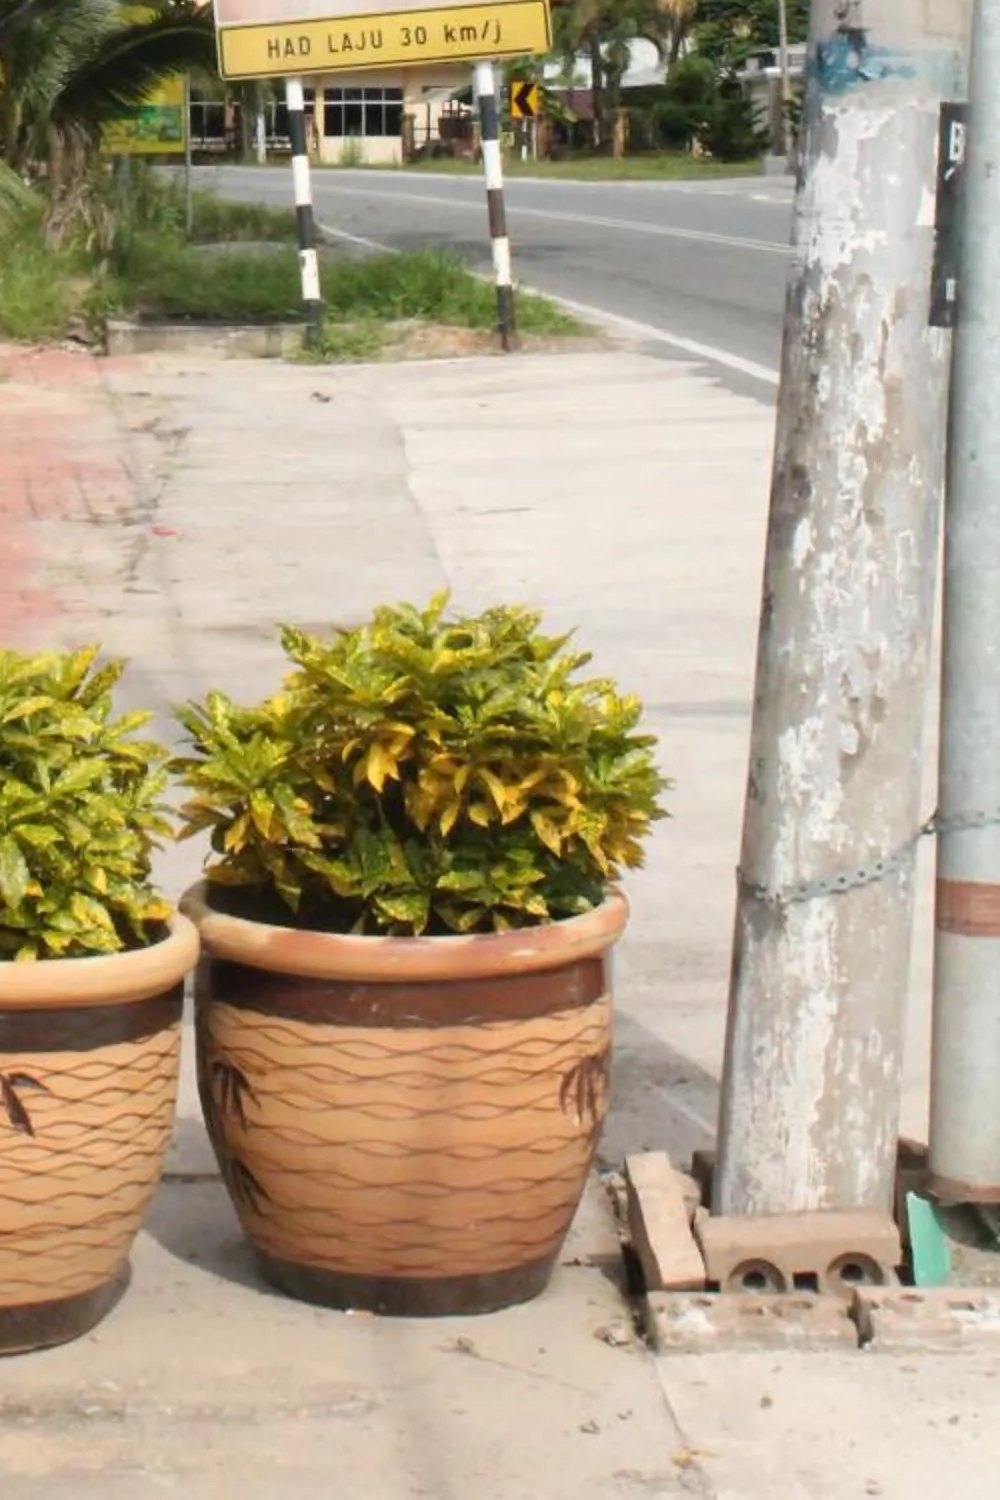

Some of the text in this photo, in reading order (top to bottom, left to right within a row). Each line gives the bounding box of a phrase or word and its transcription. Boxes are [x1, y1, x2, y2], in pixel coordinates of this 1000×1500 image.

[266, 19, 502, 58] HAD LAJU 30 km/j
